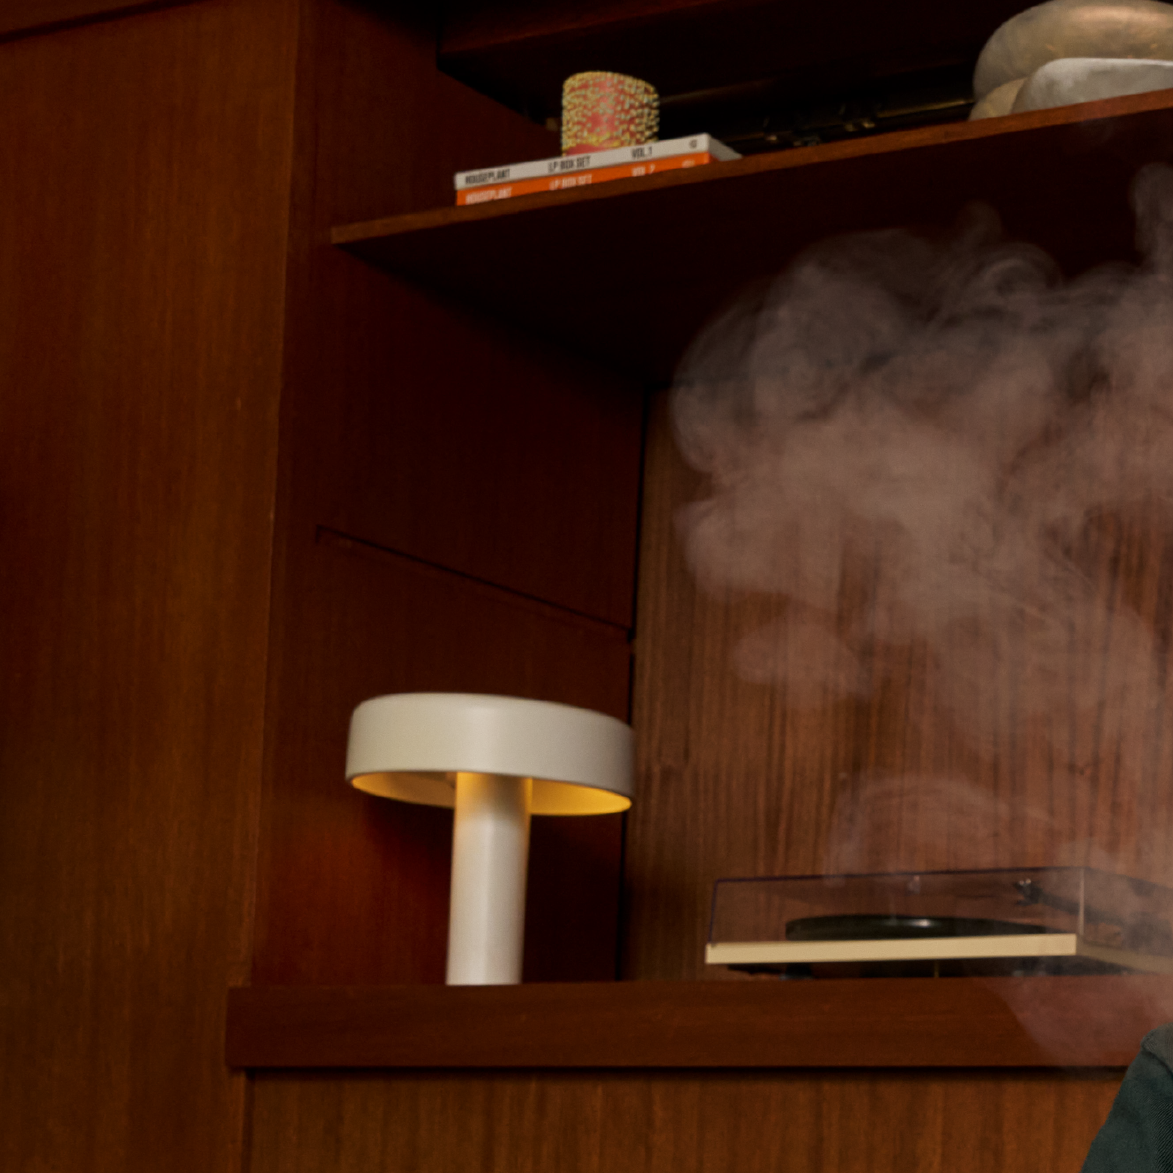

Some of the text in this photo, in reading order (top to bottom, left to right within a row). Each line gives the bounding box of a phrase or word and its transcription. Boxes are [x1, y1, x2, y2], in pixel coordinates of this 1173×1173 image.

[465, 168, 511, 185] HOUSEPLANT
[548, 161, 558, 173] LP
[560, 159, 574, 170] BOX
[576, 156, 591, 168] SET
[465, 187, 513, 205] HOUSEPLANT
